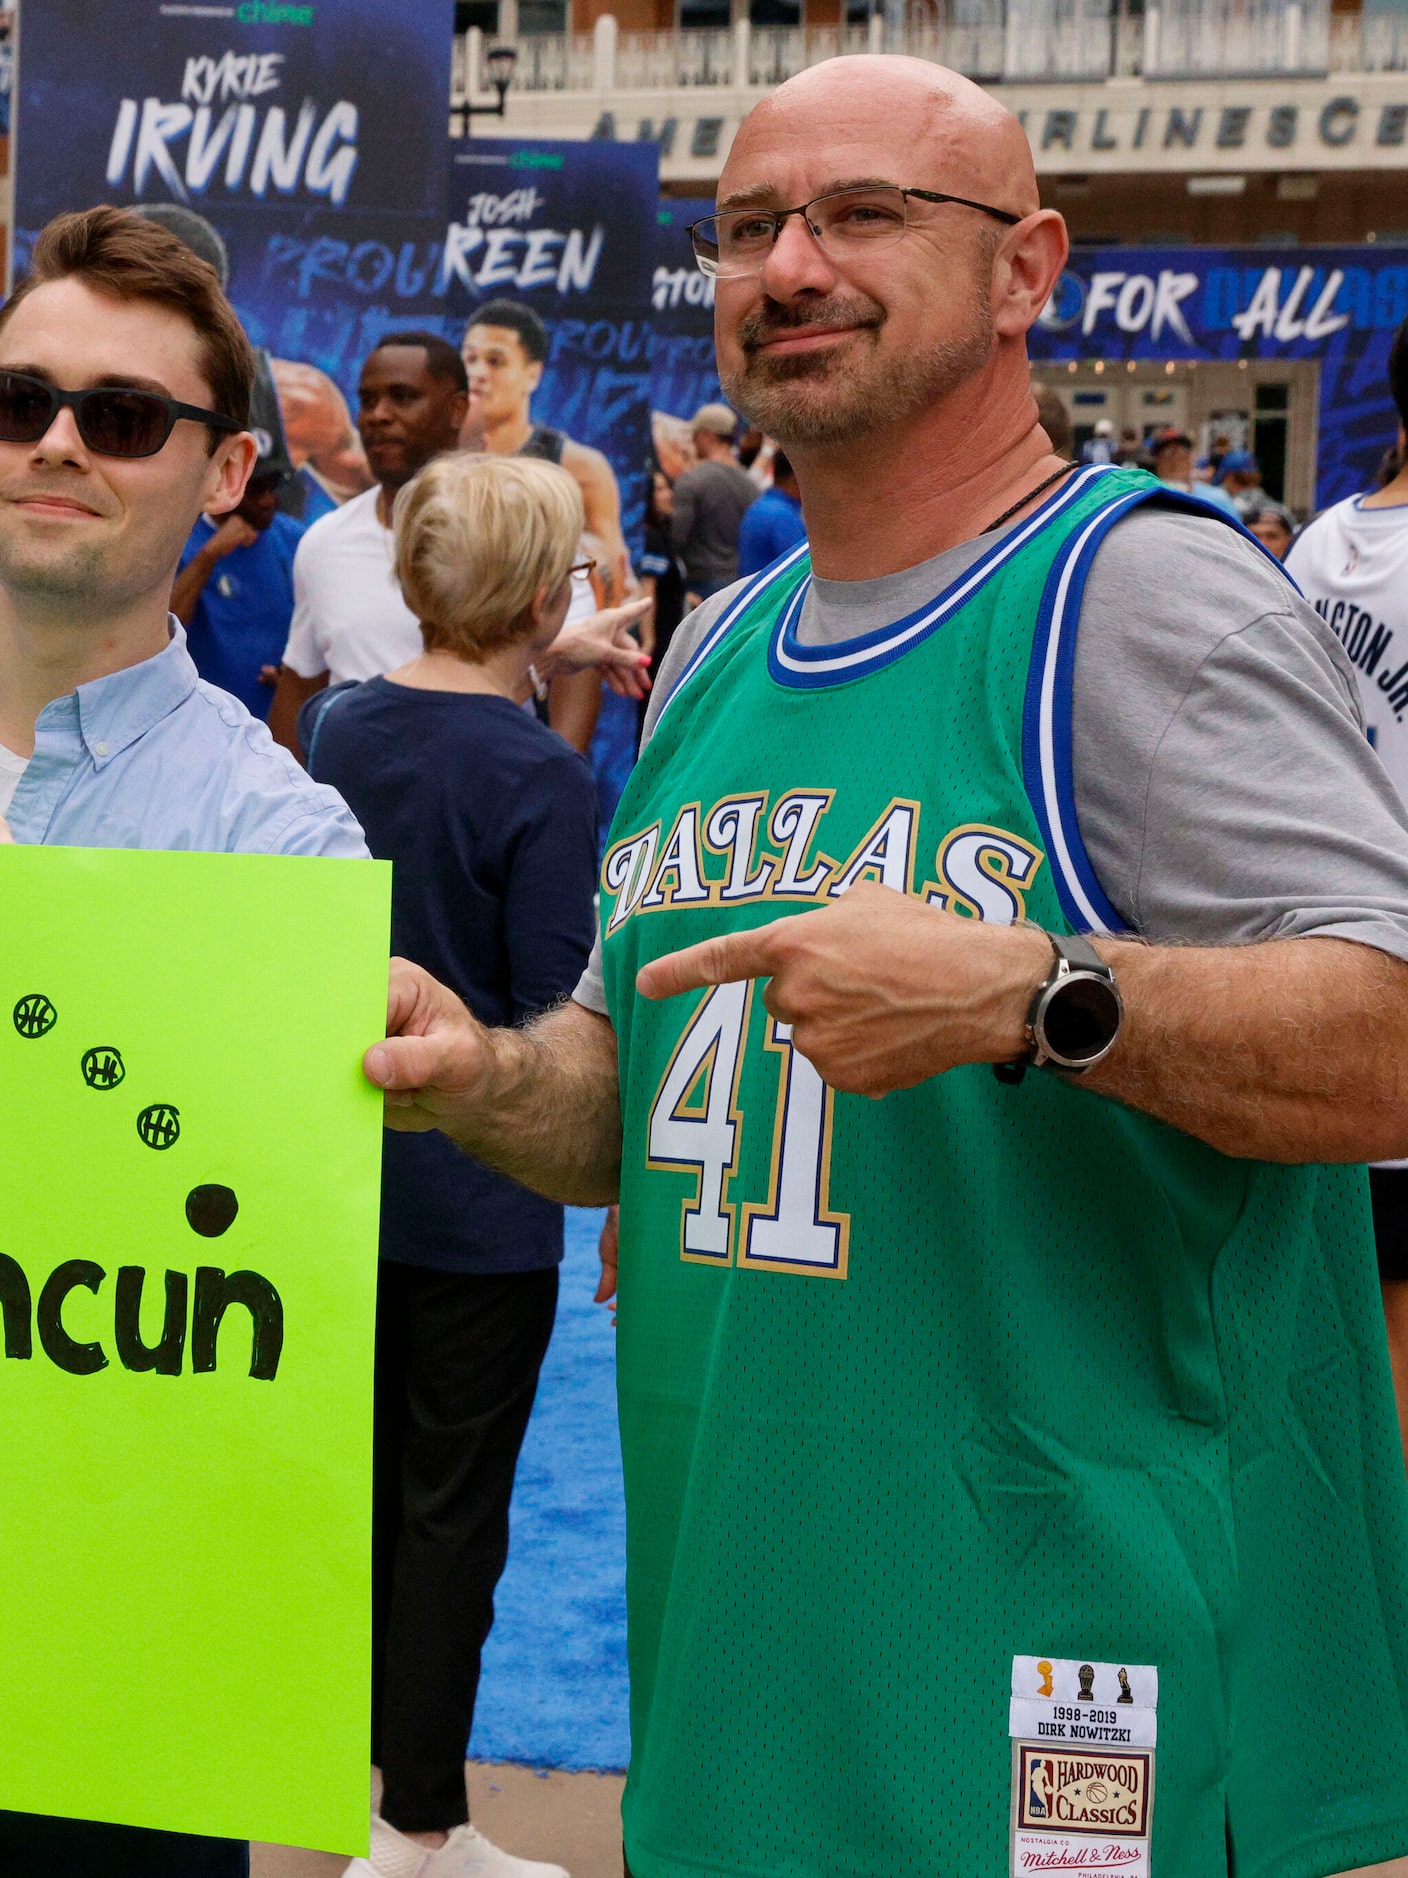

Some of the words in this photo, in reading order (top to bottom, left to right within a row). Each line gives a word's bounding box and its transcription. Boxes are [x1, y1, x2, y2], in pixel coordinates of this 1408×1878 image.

[181, 50, 286, 106] KYRIE
[106, 98, 359, 210] IRVING
[468, 186, 545, 225] JOSH
[1082, 269, 1199, 346] FOR
[1231, 265, 1349, 342] ALL
[601, 788, 1045, 940] DALLAS
[645, 978, 851, 1280] 41
[1038, 1721, 1066, 1737] DIRK
[1070, 1724, 1132, 1743] NOWITZKI
[1053, 1706, 1117, 1724] 1998-2019
[1056, 1760, 1139, 1794] HARDWOOD
[1030, 1804, 1046, 1816] NBA
[1056, 1794, 1138, 1825] CLASSICS
[1020, 1836, 1058, 1845] NOSTALGIA
[1020, 1848, 1089, 1868] Mitchell
[1089, 1848, 1101, 1863] &
[1103, 1844, 1142, 1861] Ness
